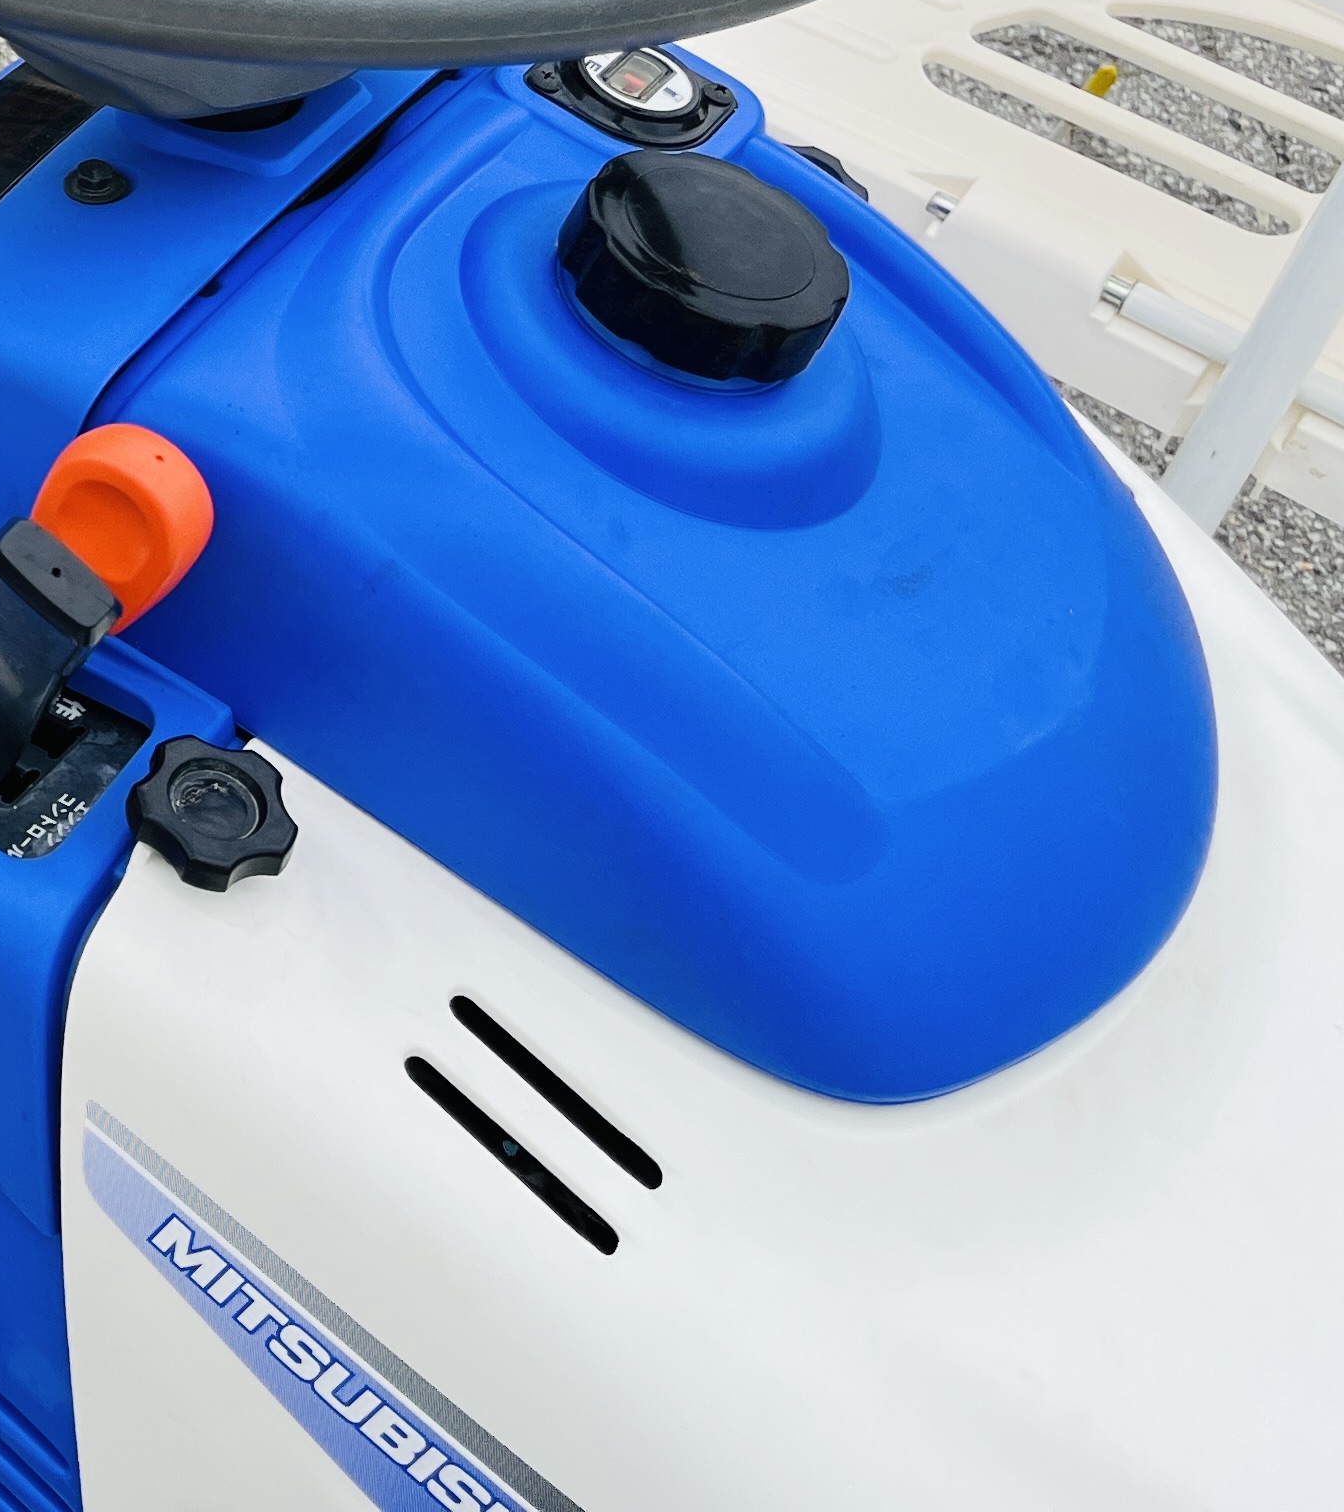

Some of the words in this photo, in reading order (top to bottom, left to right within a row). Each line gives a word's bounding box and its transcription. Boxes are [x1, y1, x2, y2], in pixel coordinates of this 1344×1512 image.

[49, 692, 88, 722] 作
[6, 792, 77, 859] コントロール
